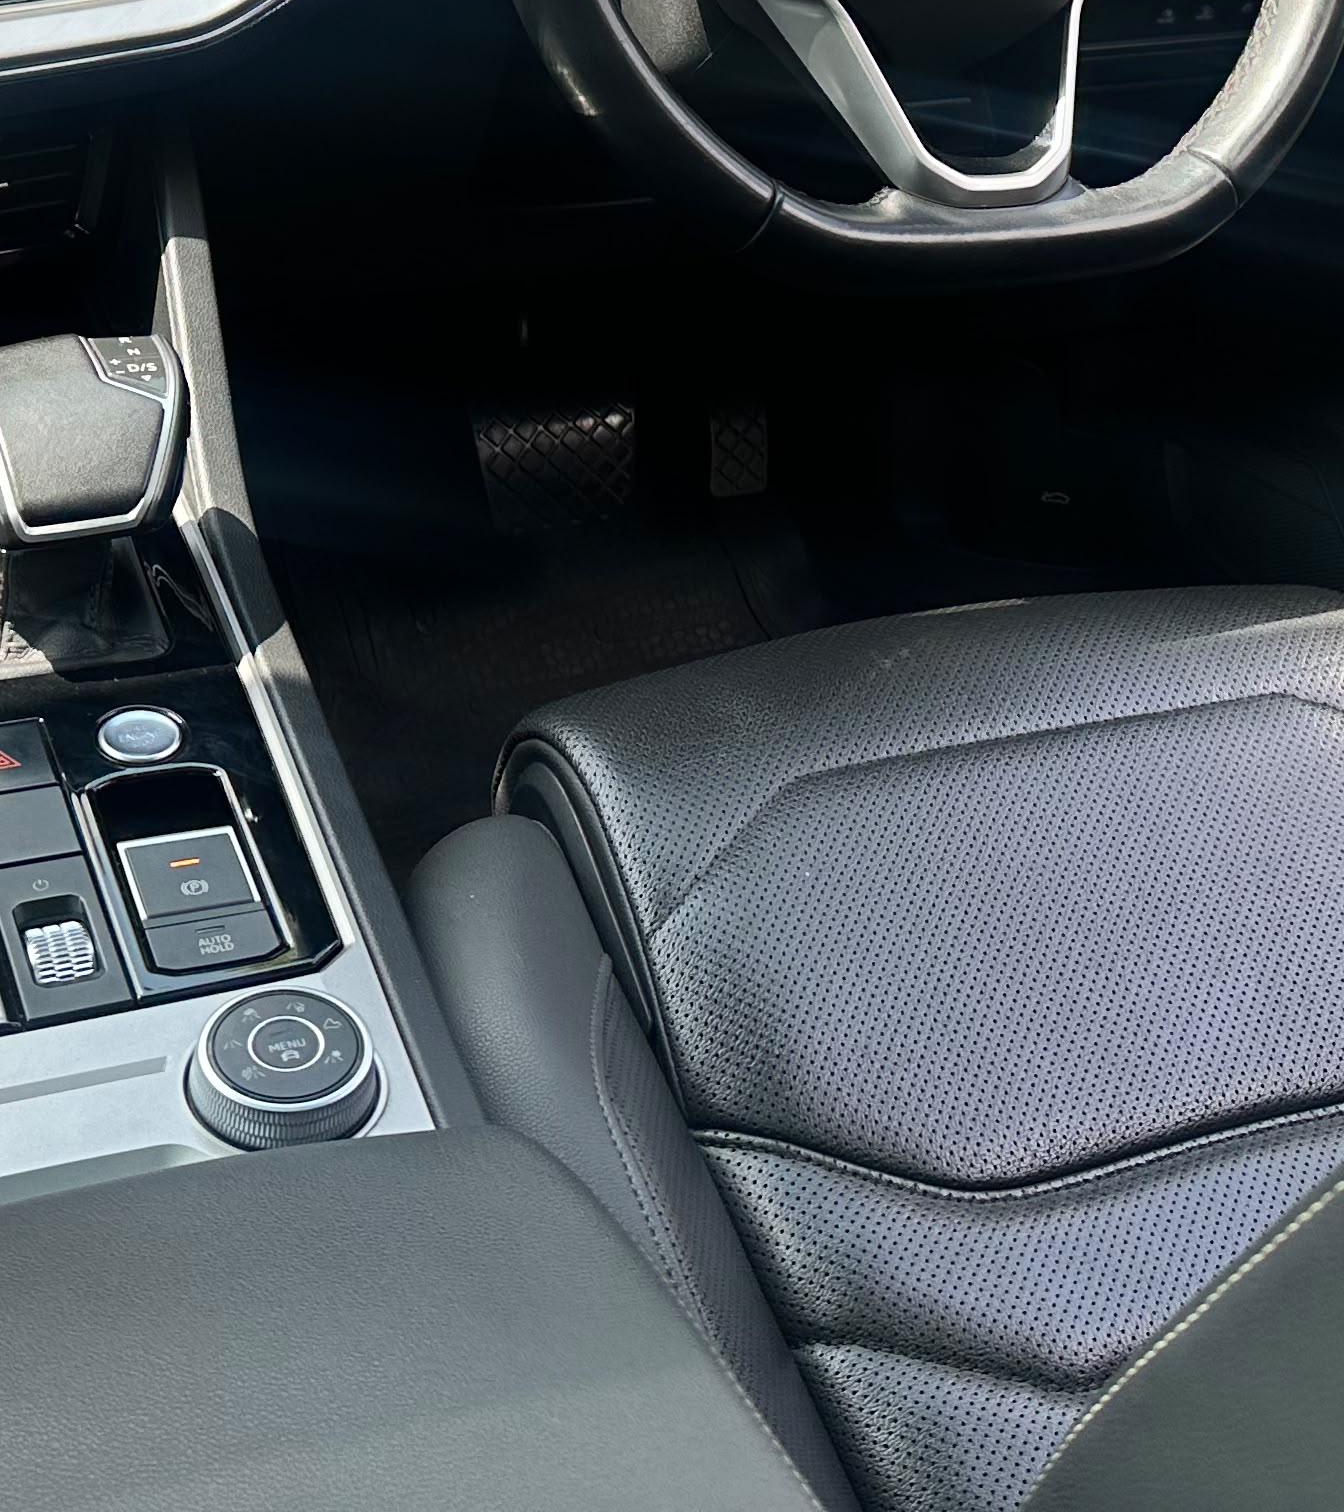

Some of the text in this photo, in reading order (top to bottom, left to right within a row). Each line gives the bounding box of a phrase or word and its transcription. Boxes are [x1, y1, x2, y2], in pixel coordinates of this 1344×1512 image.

[126, 362, 158, 373] D/S
[198, 934, 232, 948] AUTO
[200, 942, 235, 955] HOLD
[268, 1038, 306, 1053] MENU
